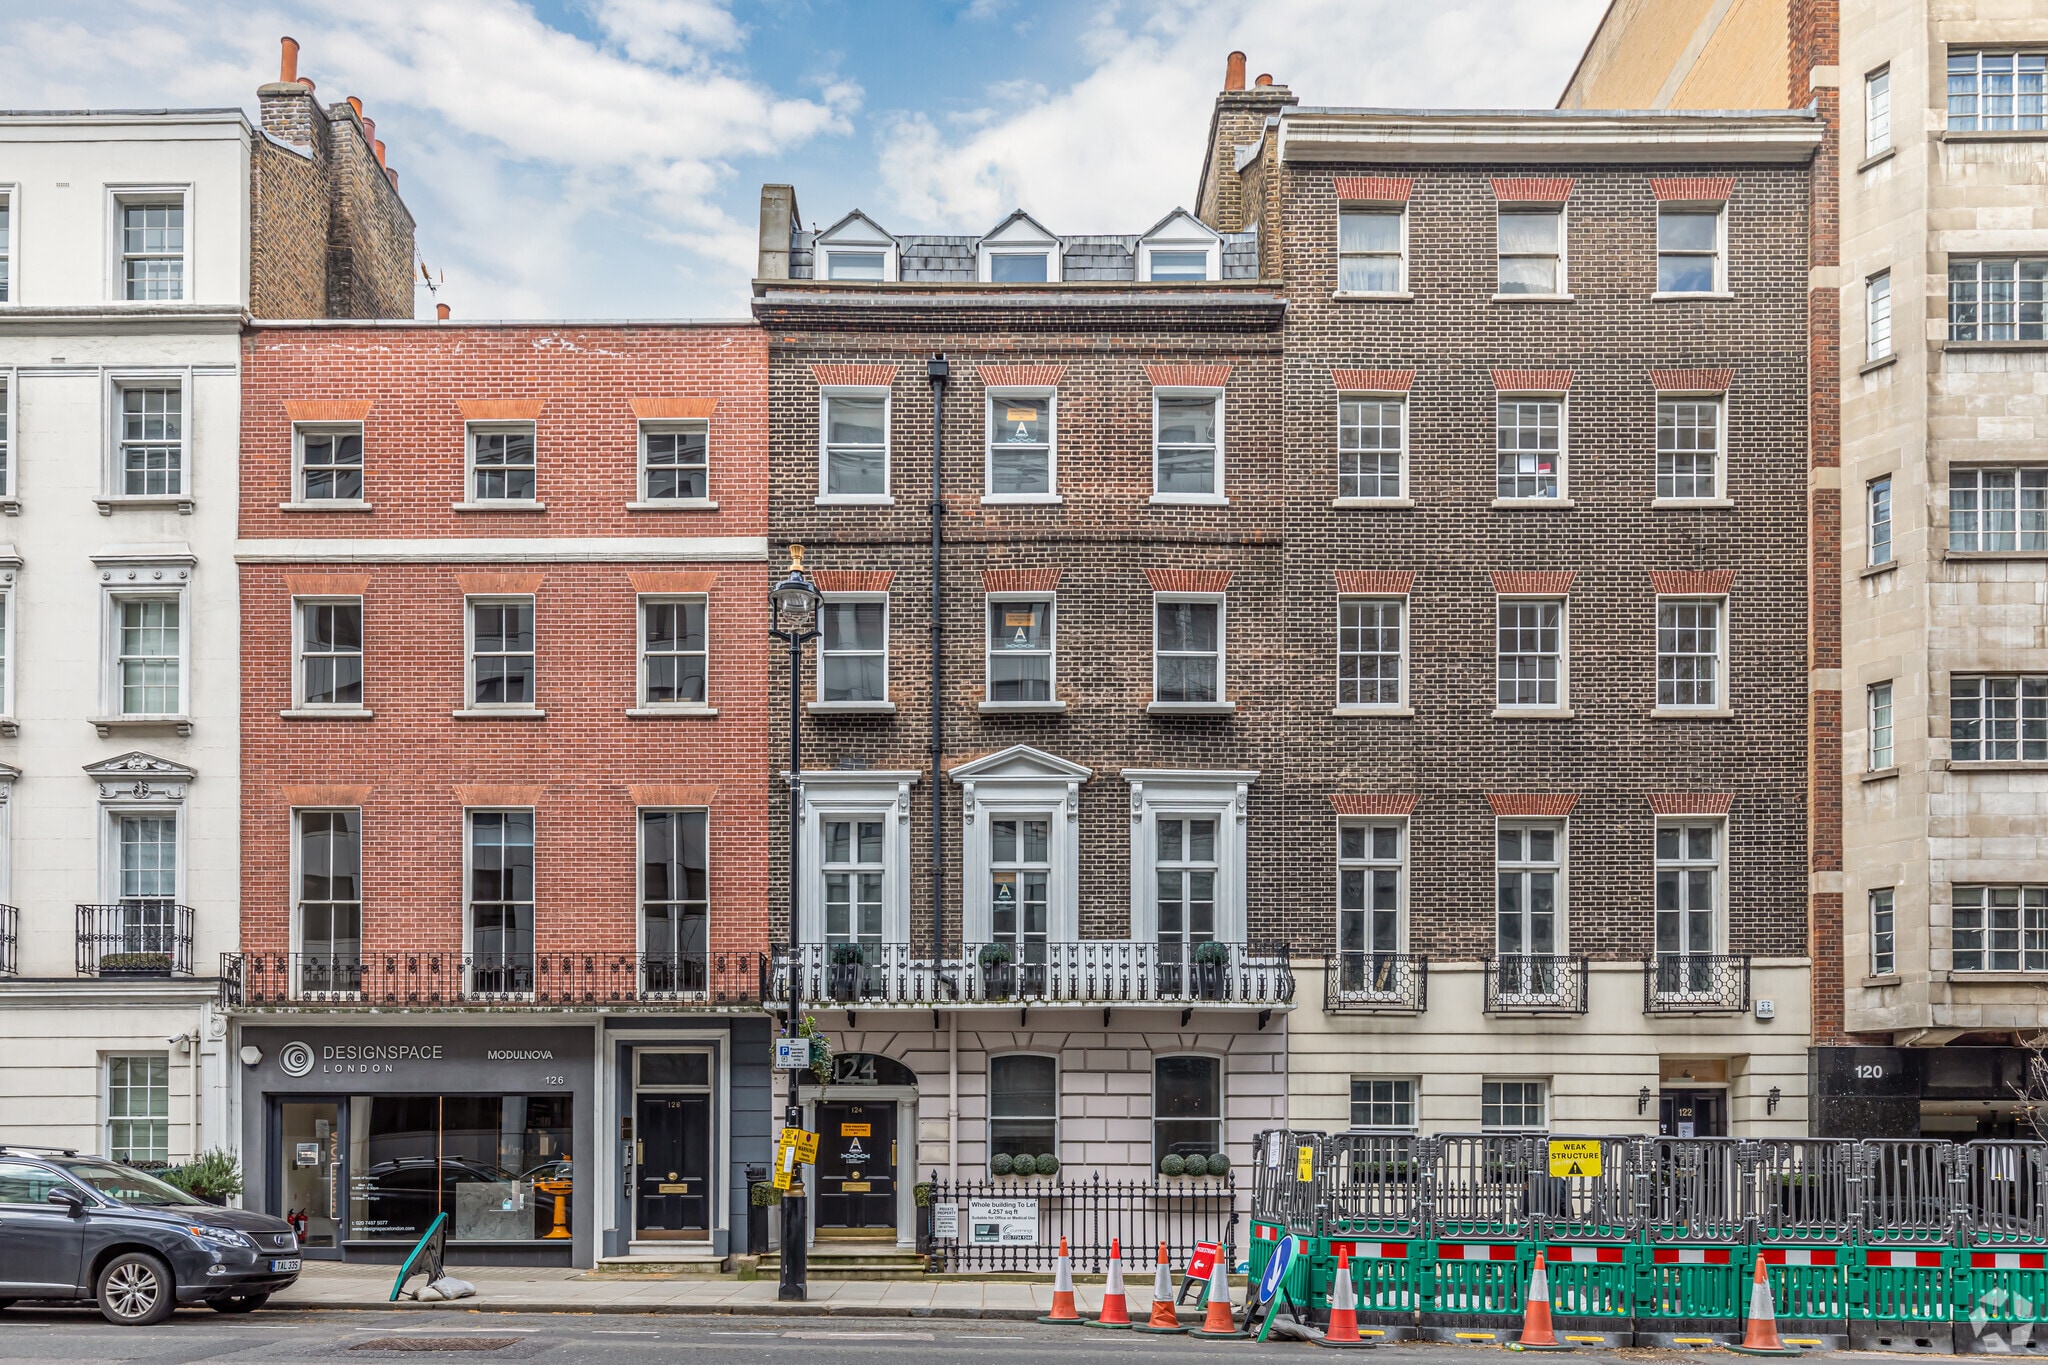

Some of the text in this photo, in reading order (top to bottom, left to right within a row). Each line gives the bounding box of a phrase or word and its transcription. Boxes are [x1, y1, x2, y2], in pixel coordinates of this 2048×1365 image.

[323, 1045, 443, 1060] DESIGNSPACE
[487, 1050, 553, 1060] MODULNOVA
[323, 1065, 394, 1073] LONDON
[834, 1058, 877, 1081] 124
[1854, 1065, 1883, 1078] 120
[544, 1076, 564, 1084] 126
[1679, 1108, 1693, 1117] 122
[798, 1146, 815, 1154] WARNING
[278, 1261, 298, 1270] TAL 33S
